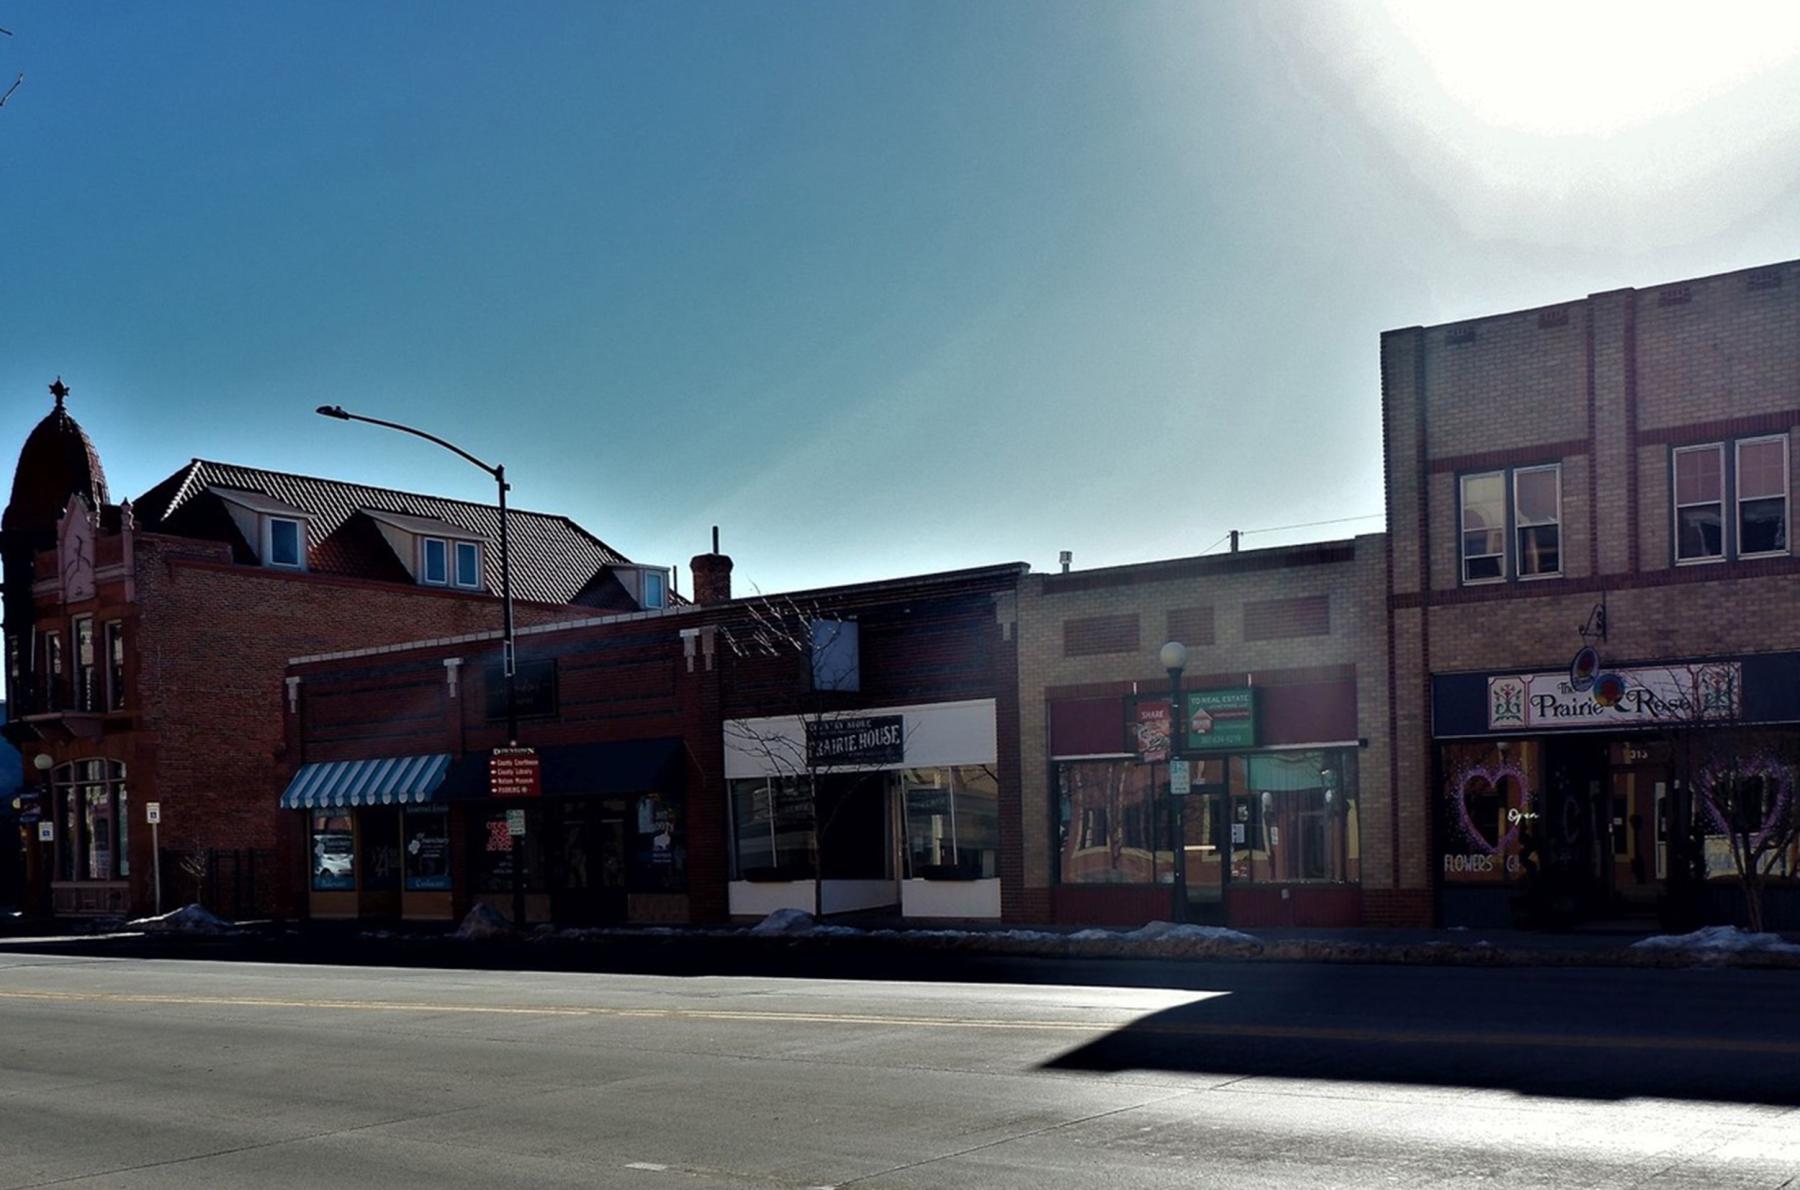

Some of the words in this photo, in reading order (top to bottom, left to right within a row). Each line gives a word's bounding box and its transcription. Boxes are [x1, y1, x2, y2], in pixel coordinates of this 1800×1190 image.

[1222, 694, 1249, 703] ESTATE
[1530, 694, 1604, 718] Prairie
[1625, 688, 1692, 718] Rose
[859, 724, 901, 752] HOUSE
[1507, 808, 1540, 826] Open
[1444, 853, 1494, 873] FLOWERS
